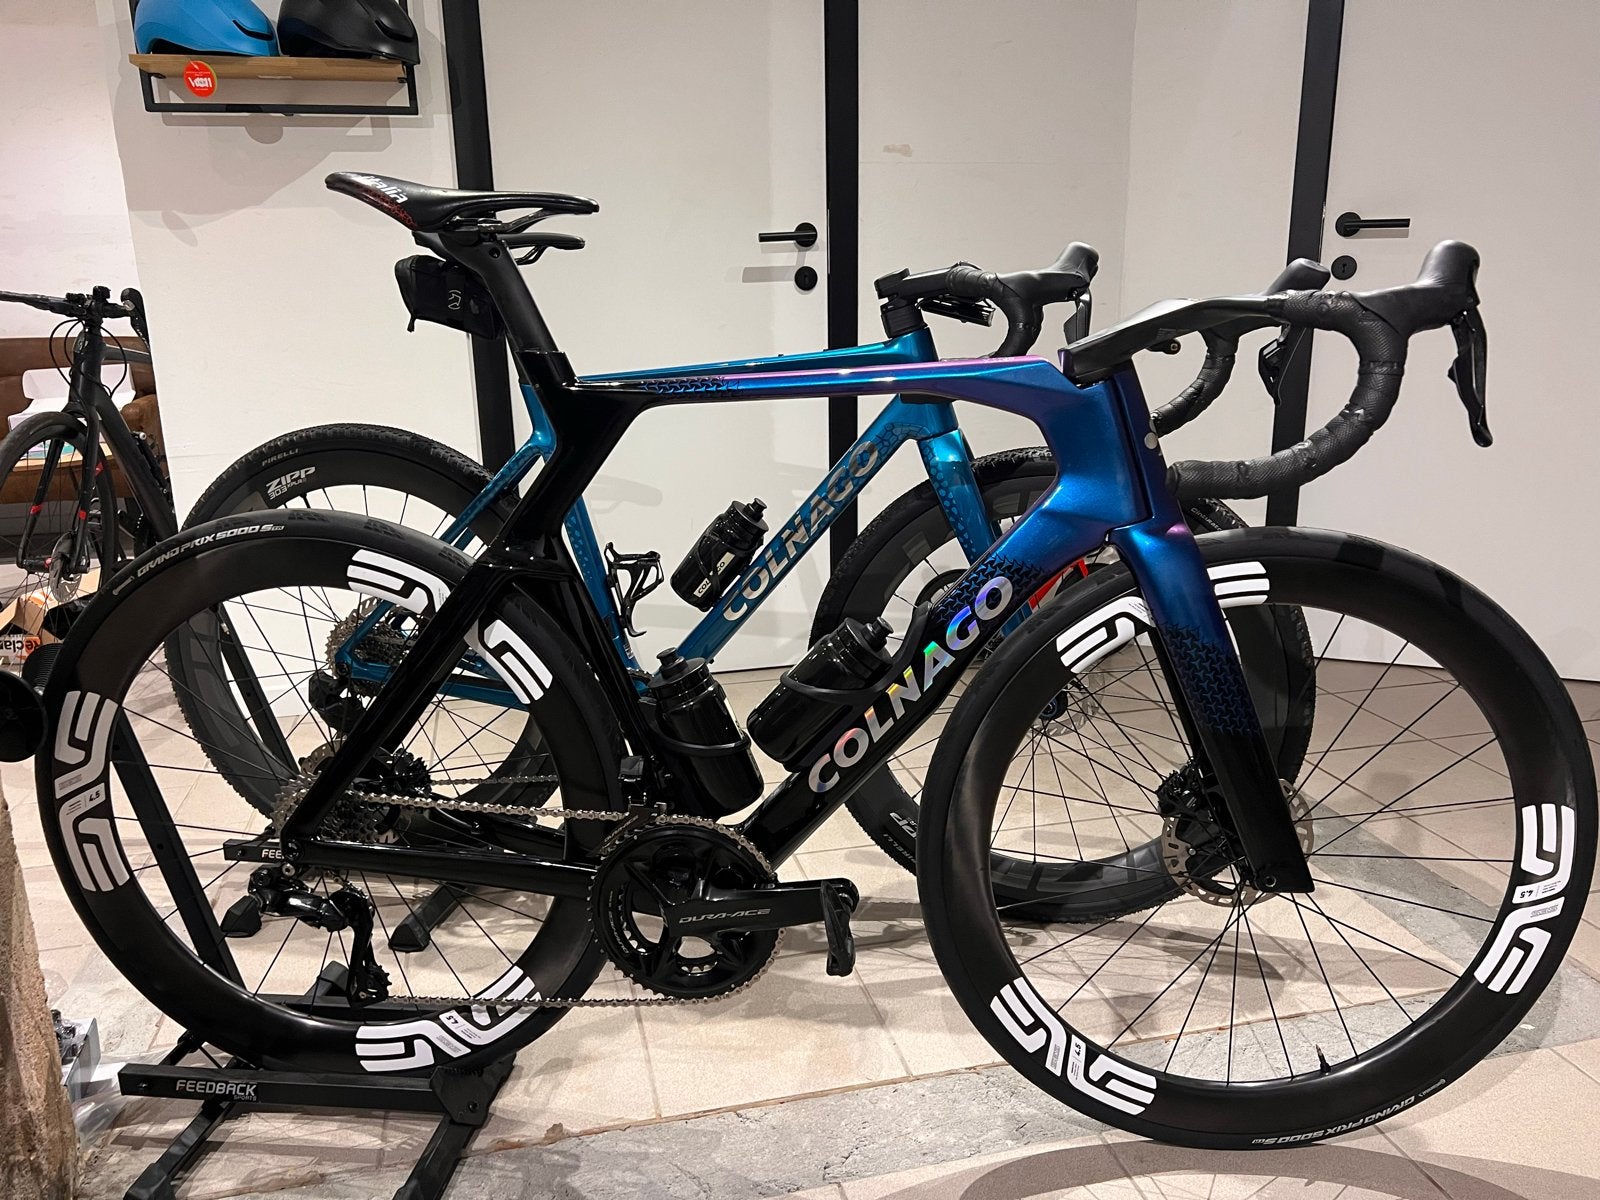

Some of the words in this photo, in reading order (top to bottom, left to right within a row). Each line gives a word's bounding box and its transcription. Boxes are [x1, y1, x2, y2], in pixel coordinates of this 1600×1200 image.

[265, 466, 316, 494] ZIPP
[723, 440, 878, 621] COLNAGO
[137, 547, 180, 577] GRAND
[180, 534, 217, 553] PRIX
[215, 525, 261, 540] 5000
[808, 576, 1013, 793] COLNAGO
[88, 788, 101, 802] 4.5
[1519, 889, 1534, 899] 4.5
[678, 908, 772, 925] DURA-ACE
[445, 1014, 458, 1026] 4.5
[1074, 1042, 1082, 1057] 4.5
[175, 1079, 258, 1097] FEEDBACK
[1363, 1095, 1416, 1124] GRAND
[1325, 1118, 1364, 1136] PRIX
[1276, 1129, 1325, 1144] 5000
